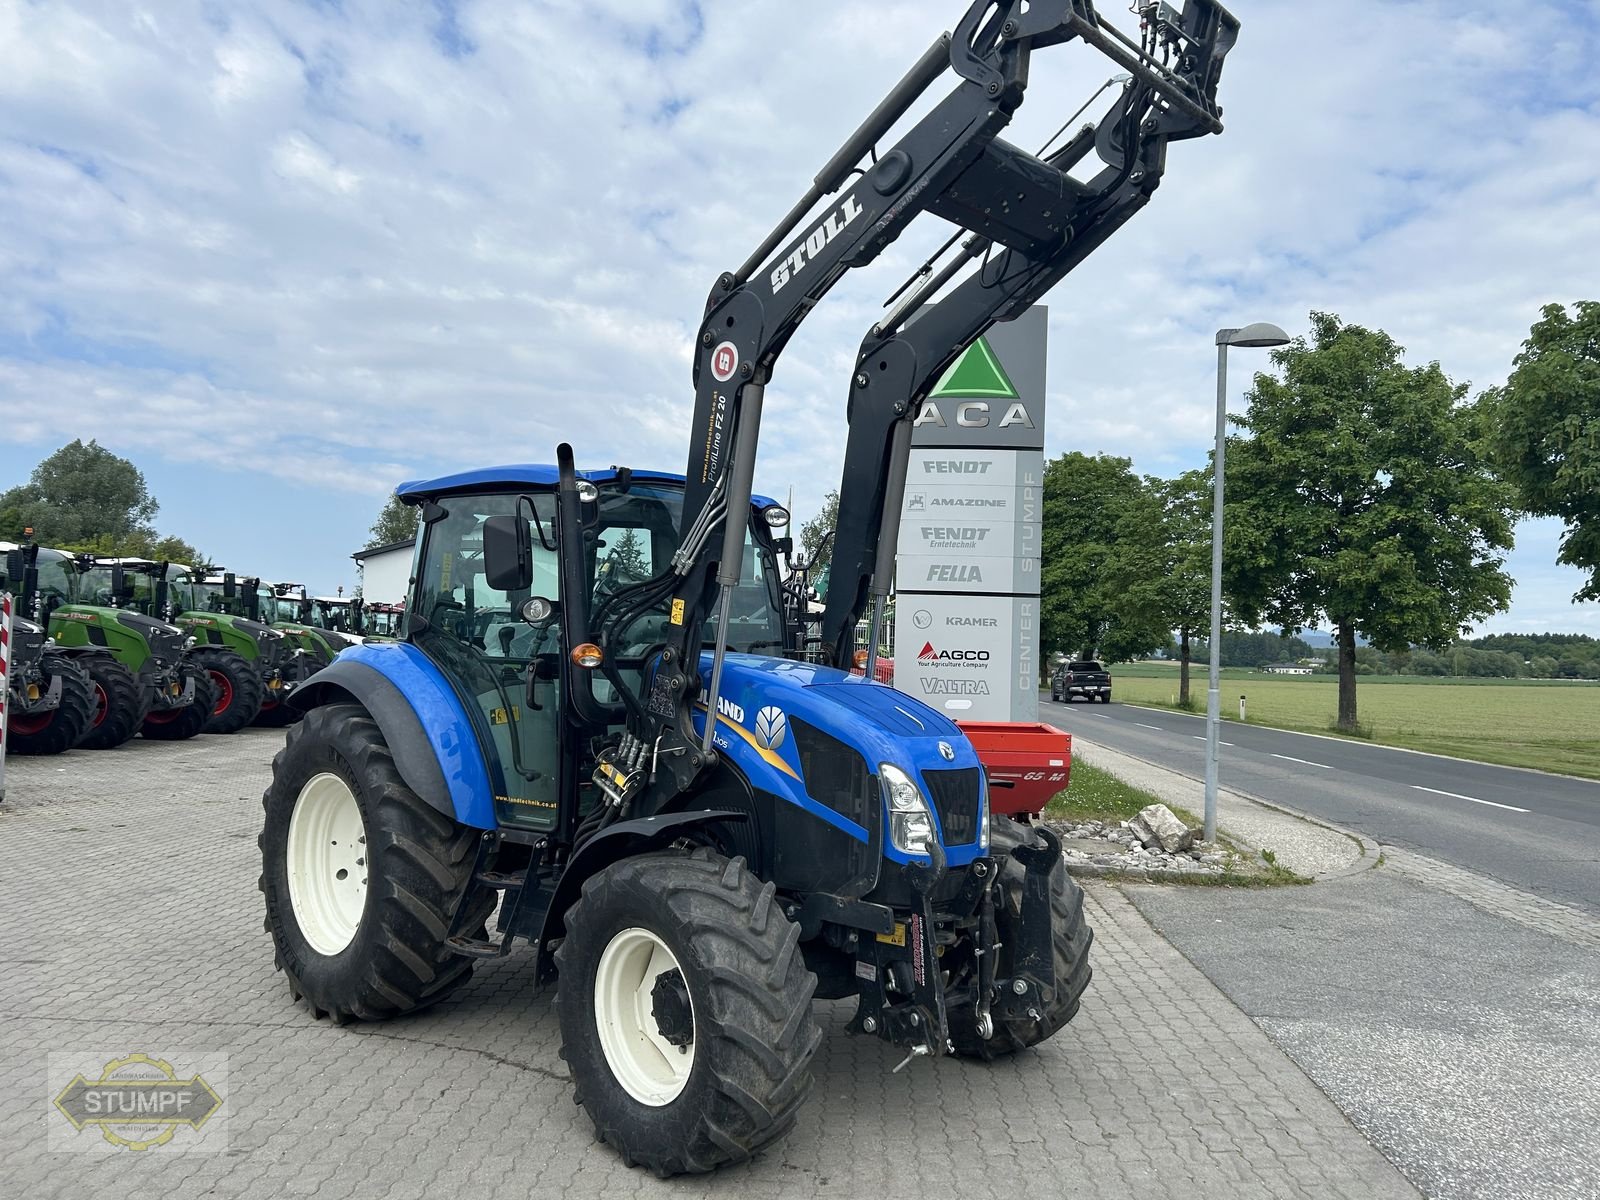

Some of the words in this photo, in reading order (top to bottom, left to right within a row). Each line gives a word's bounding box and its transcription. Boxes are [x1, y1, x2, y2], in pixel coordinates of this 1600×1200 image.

[770, 193, 863, 295] STOLL
[718, 395, 726, 411] 20
[715, 413, 724, 430] FZ
[913, 402, 1036, 429] ACA
[708, 432, 721, 482] ProfiLine
[922, 461, 993, 474] FENDT
[930, 498, 1007, 507] AMAZONE
[1021, 472, 1035, 572] STUMPF
[920, 527, 991, 541] FENDT
[929, 541, 976, 549] Erntetechnik
[926, 565, 983, 582] FELLA
[945, 616, 998, 627] KRAMER
[1020, 603, 1032, 690] CENTER
[939, 650, 990, 661] AGCO
[920, 678, 990, 695] VALTRA
